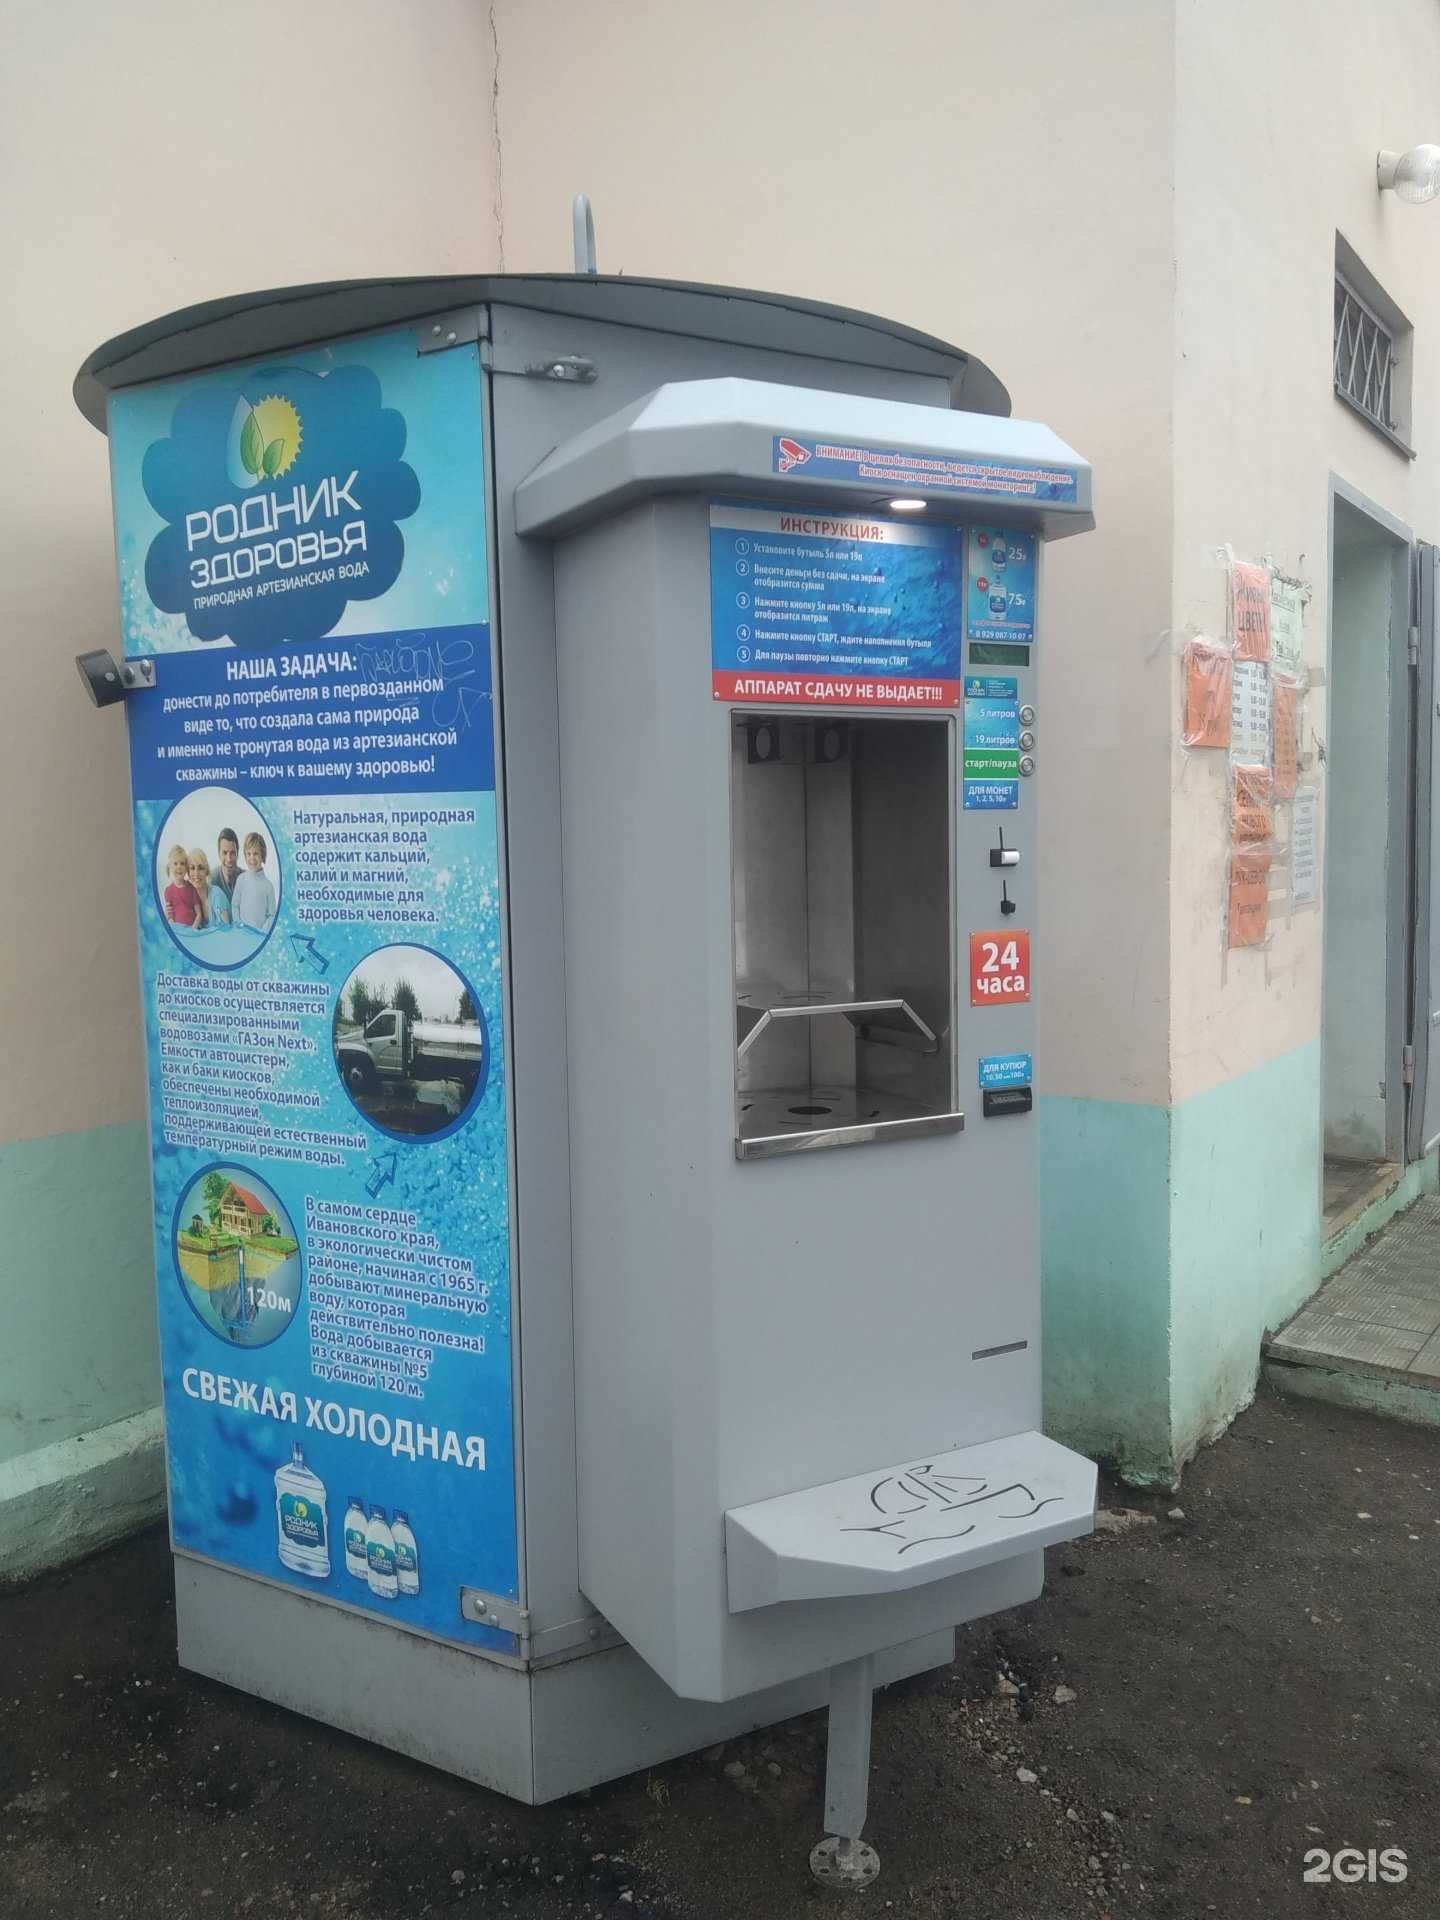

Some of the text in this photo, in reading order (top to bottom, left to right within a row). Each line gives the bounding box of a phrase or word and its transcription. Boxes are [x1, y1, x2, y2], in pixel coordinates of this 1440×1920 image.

[185, 470, 362, 551] РОДНИК
[780, 518, 884, 541] ИНСТРУКЦИЯ:
[190, 520, 367, 589] ЗДОРОВЬЯ
[754, 543, 795, 555] Установите
[797, 546, 824, 558] бутыль
[825, 549, 834, 559] 5л
[835, 551, 849, 560] или
[754, 564, 784, 576] Внесите
[785, 567, 811, 578] деньги
[813, 568, 825, 578] без
[826, 571, 849, 581] сдачи,
[851, 573, 860, 581] на
[194, 561, 369, 609] ПРИРОДНАЯ АРТЕЗИАНСКАЯ ВОДА
[754, 578, 824, 591] отобразится сумма
[754, 597, 789, 609] Нажмите
[790, 600, 816, 613] кнопку
[827, 603, 840, 612] или
[754, 610, 800, 622] отобразится
[755, 630, 789, 641] Нажмите
[790, 632, 816, 644] кнопку
[817, 633, 839, 643] СТАРТ,
[840, 635, 863, 645] ждите
[226, 656, 276, 681] НАША
[281, 651, 358, 678] ЗАДАЧА:
[754, 650, 908, 666] Для паузы повторно нажмите кнопку СТАРТ
[163, 678, 443, 712] донести до потребителя в первозданном
[735, 680, 942, 701] АППАРАТ СДАЧУ НЕ ВЫДАЕТ!!!
[184, 706, 419, 734] виде то, что создала сама природа
[986, 710, 1015, 719] литров
[158, 728, 458, 758] и именно не тронутая вода из артезианской
[976, 734, 1015, 745] 19 литров
[176, 756, 434, 782] скважины ключ к вашему здоровью!
[965, 759, 1016, 770] старт/пауза
[969, 786, 1012, 795] ДЛЯ МОНЕТ
[294, 809, 475, 827] Натуральная, природная
[295, 830, 427, 846] артезианская вода
[295, 848, 430, 865] содержит кальций,
[297, 868, 409, 884] калий и магний,
[298, 886, 424, 903] необходимые для
[299, 908, 439, 923] здоровья человека.
[982, 941, 1019, 973] 24
[158, 973, 329, 996] Доставка воды от скважины
[977, 975, 1025, 994] часа
[159, 994, 325, 1014] до киосков осуществляется
[159, 1011, 300, 1031] специализированными
[160, 1028, 317, 1051] водовозами «ГАЗон Next».
[161, 1043, 290, 1069] Емкости автоцистерн,
[984, 1061, 1027, 1073] ДЛЯ КУПЮР
[162, 1063, 275, 1085] как и баки киосков,
[163, 1079, 319, 1107] обеспечены необходимой
[163, 1097, 262, 1119] теплоизоляцией,
[165, 1113, 367, 1149] поддерживающей естественный
[165, 1130, 345, 1165] температурный режим воды.
[306, 1198, 416, 1226] В самом сердце
[306, 1215, 439, 1248] Ивановского края,
[308, 1237, 472, 1272] в экологически чистом
[308, 1253, 489, 1296] районе, начиная с 1965 г.
[246, 1286, 291, 1313] 120м
[309, 1273, 486, 1314] добывают минеральную
[310, 1290, 405, 1318] воду, которая
[311, 1309, 484, 1352] действительно полезна!
[311, 1325, 432, 1361] Вода добывается
[312, 1345, 427, 1378] из скважины №5
[313, 1363, 424, 1397] глубиной 120 м.
[182, 1367, 486, 1471] СВЕЖАЯ ХОЛОДНАЯ
